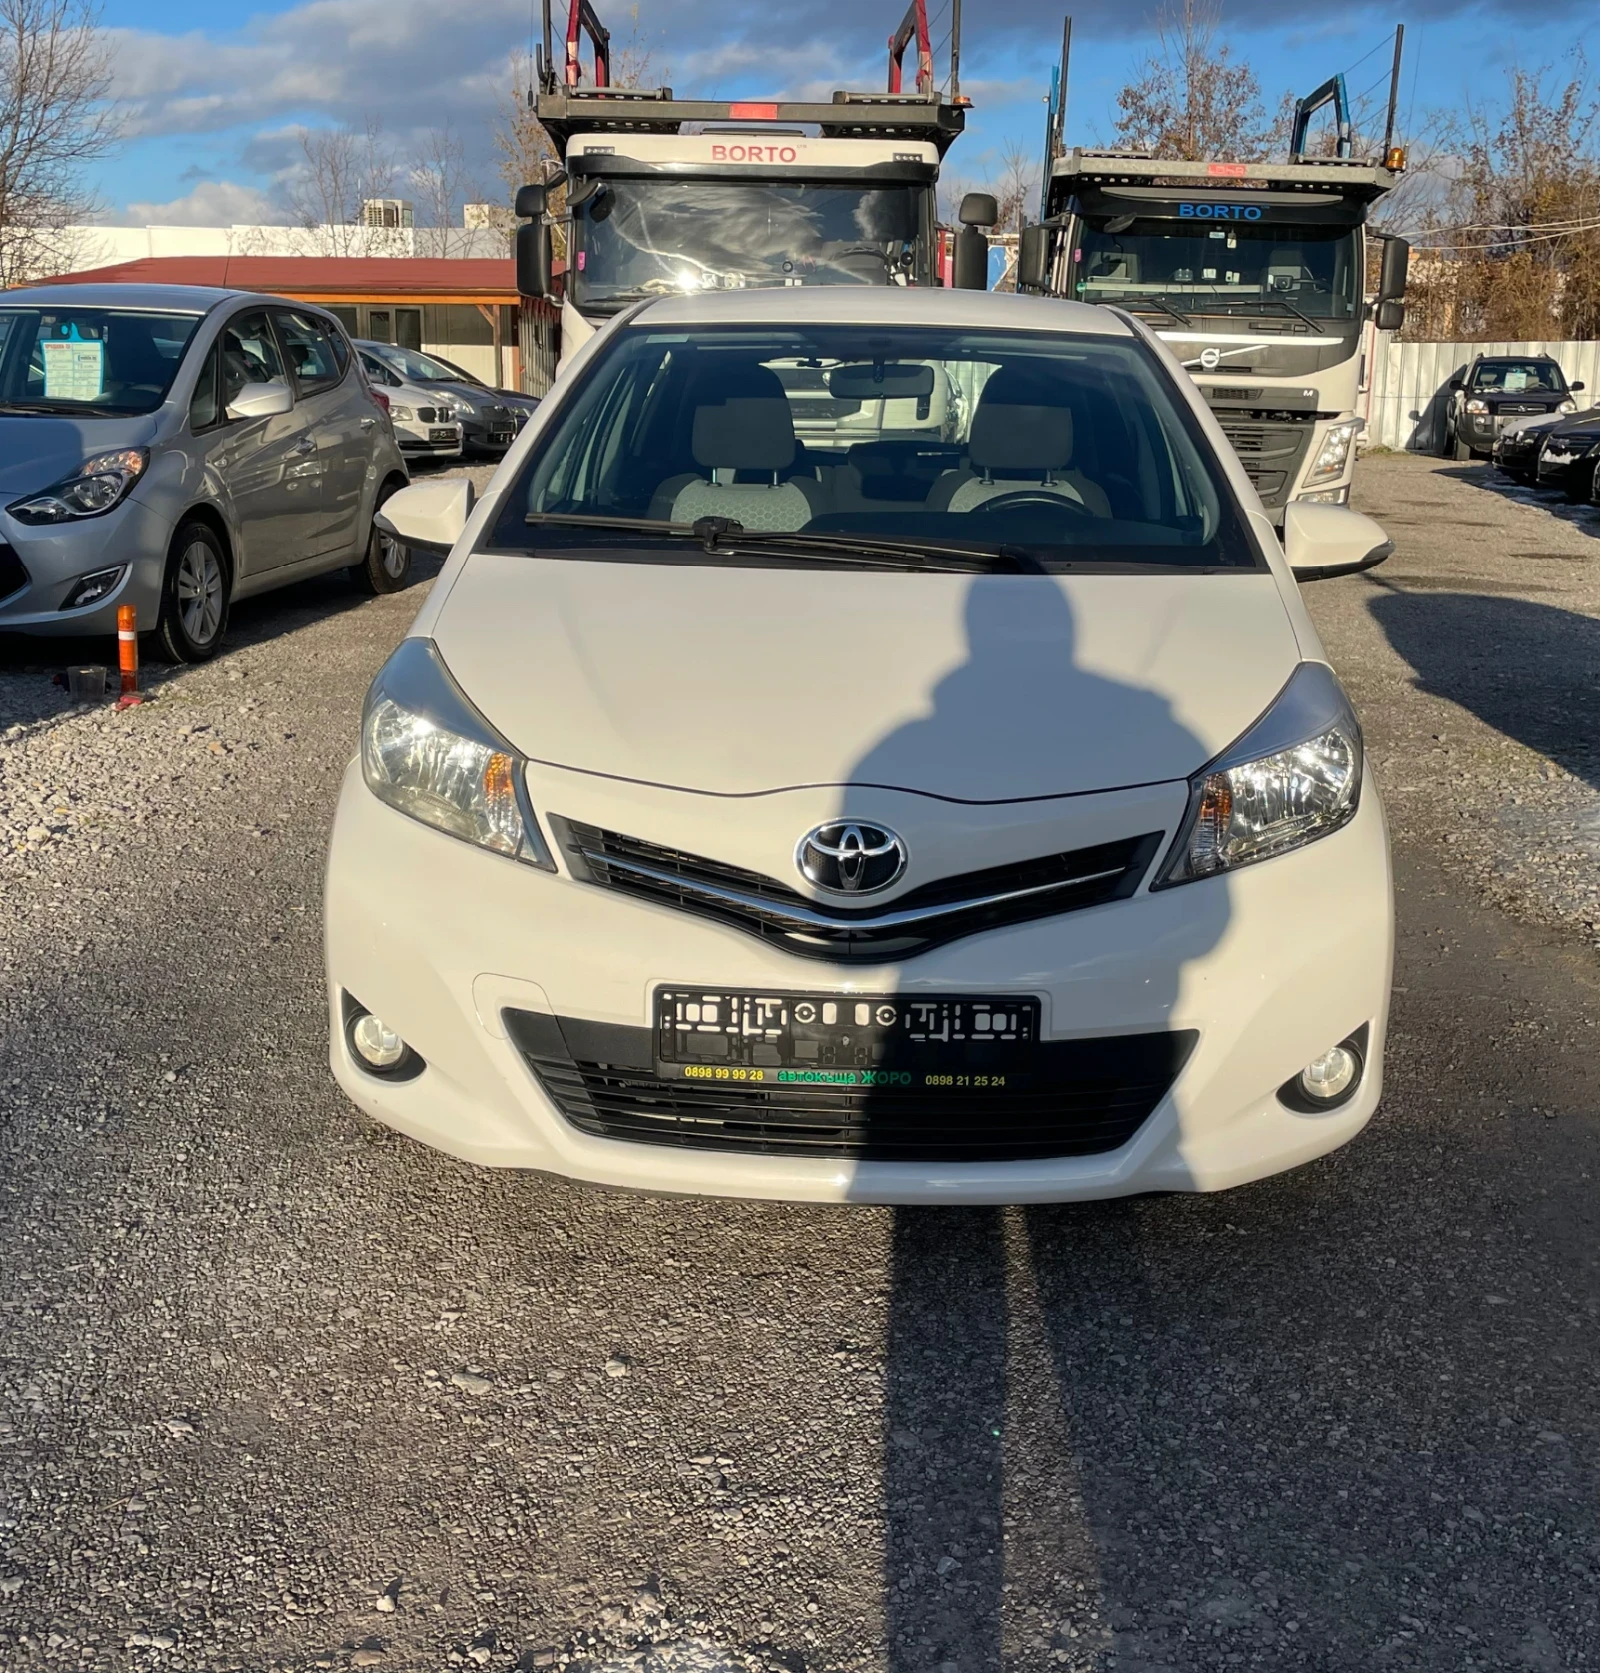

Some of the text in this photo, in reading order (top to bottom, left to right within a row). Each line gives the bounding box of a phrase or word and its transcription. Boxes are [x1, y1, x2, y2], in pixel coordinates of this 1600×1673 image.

[712, 145, 797, 163] BORTO
[1179, 203, 1262, 220] BORTO
[684, 1066, 764, 1081] 0898 99 99 28
[778, 1070, 912, 1085] автокъща ЖОРО
[925, 1075, 1006, 1087] 0898 21 25 24
